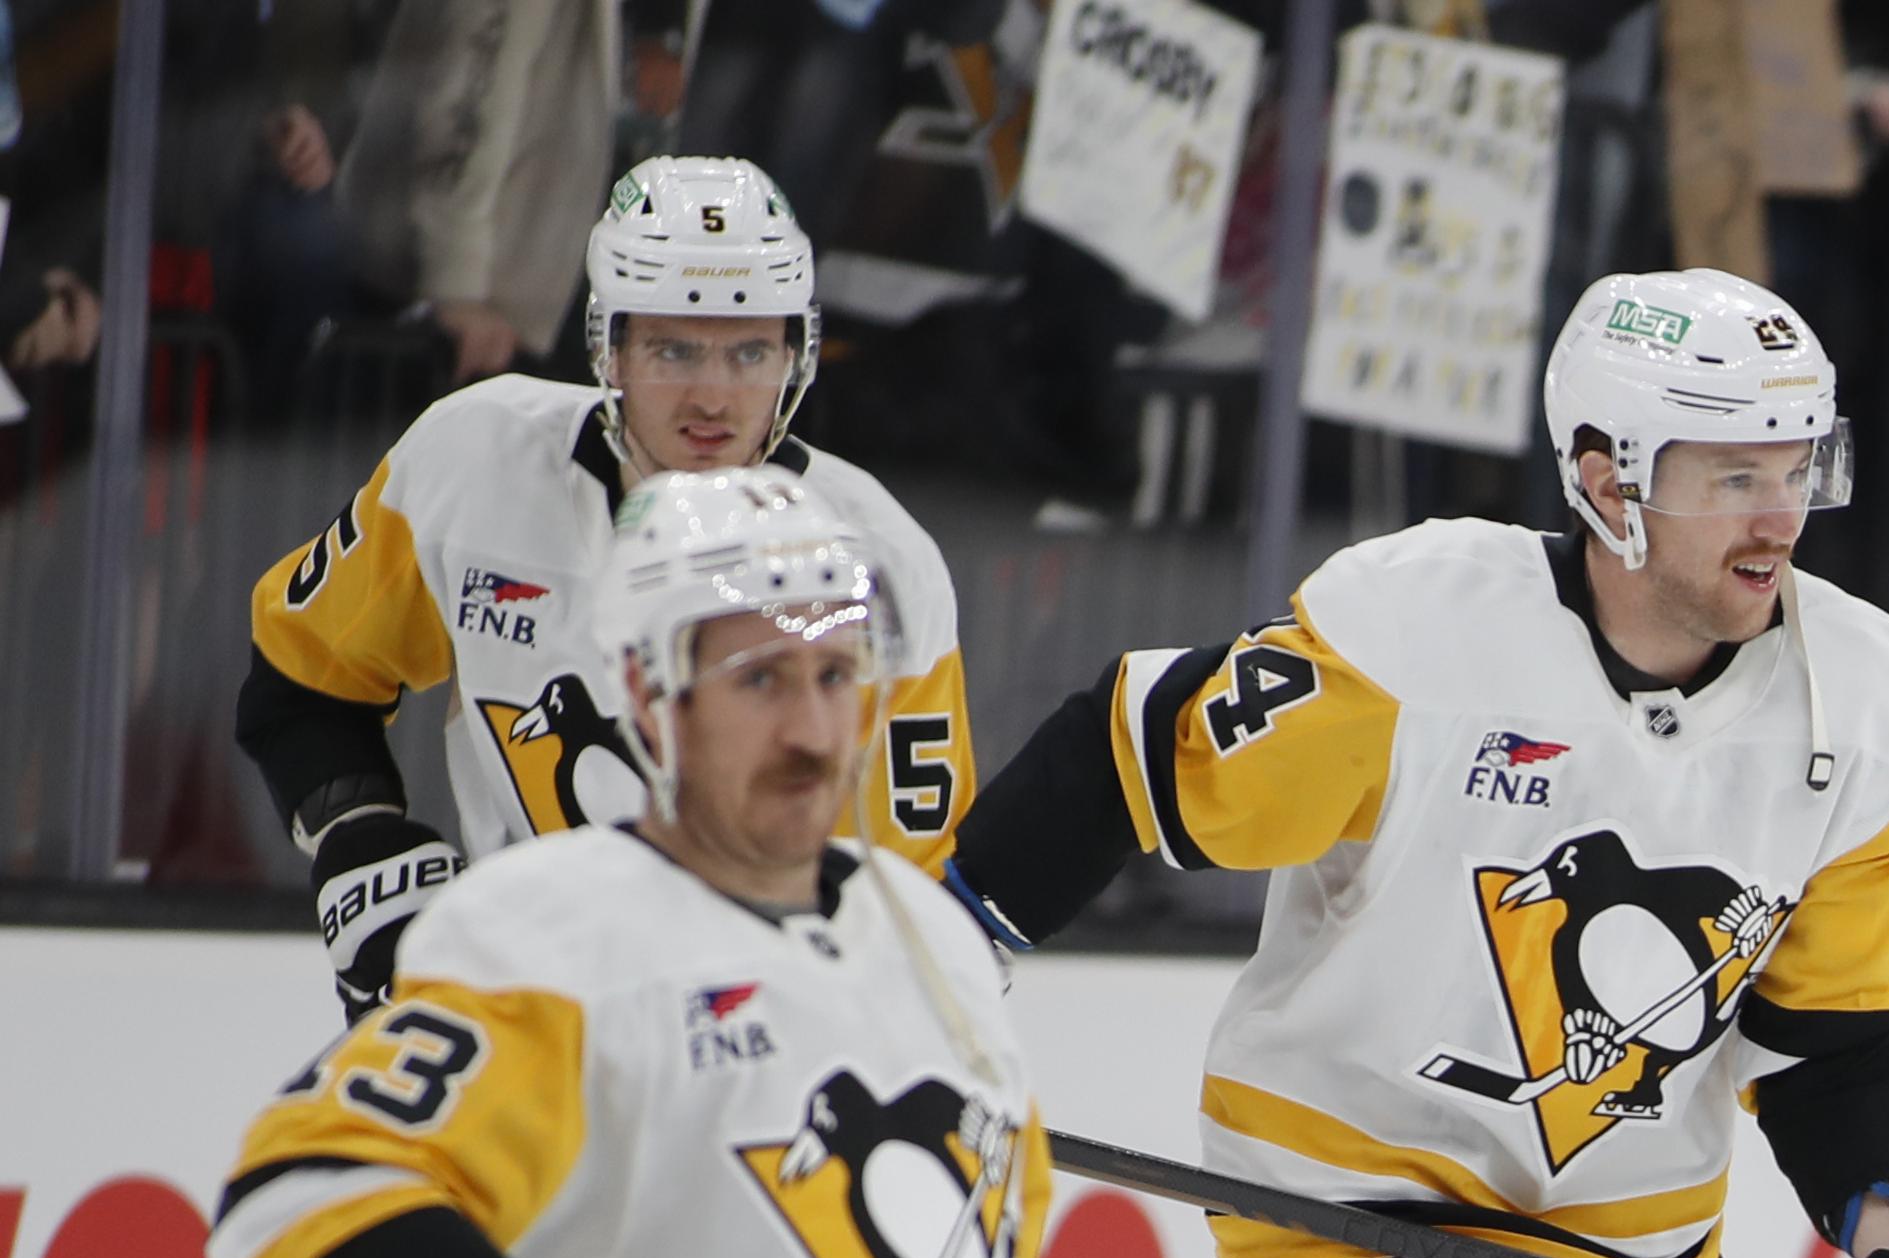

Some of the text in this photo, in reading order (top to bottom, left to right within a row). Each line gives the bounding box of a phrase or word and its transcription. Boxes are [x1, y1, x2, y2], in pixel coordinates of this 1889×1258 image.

[702, 205, 726, 233] 5
[1610, 303, 1682, 341] MSA
[287, 487, 362, 612] 5
[1203, 615, 1323, 758] 4
[885, 712, 956, 836] 5
